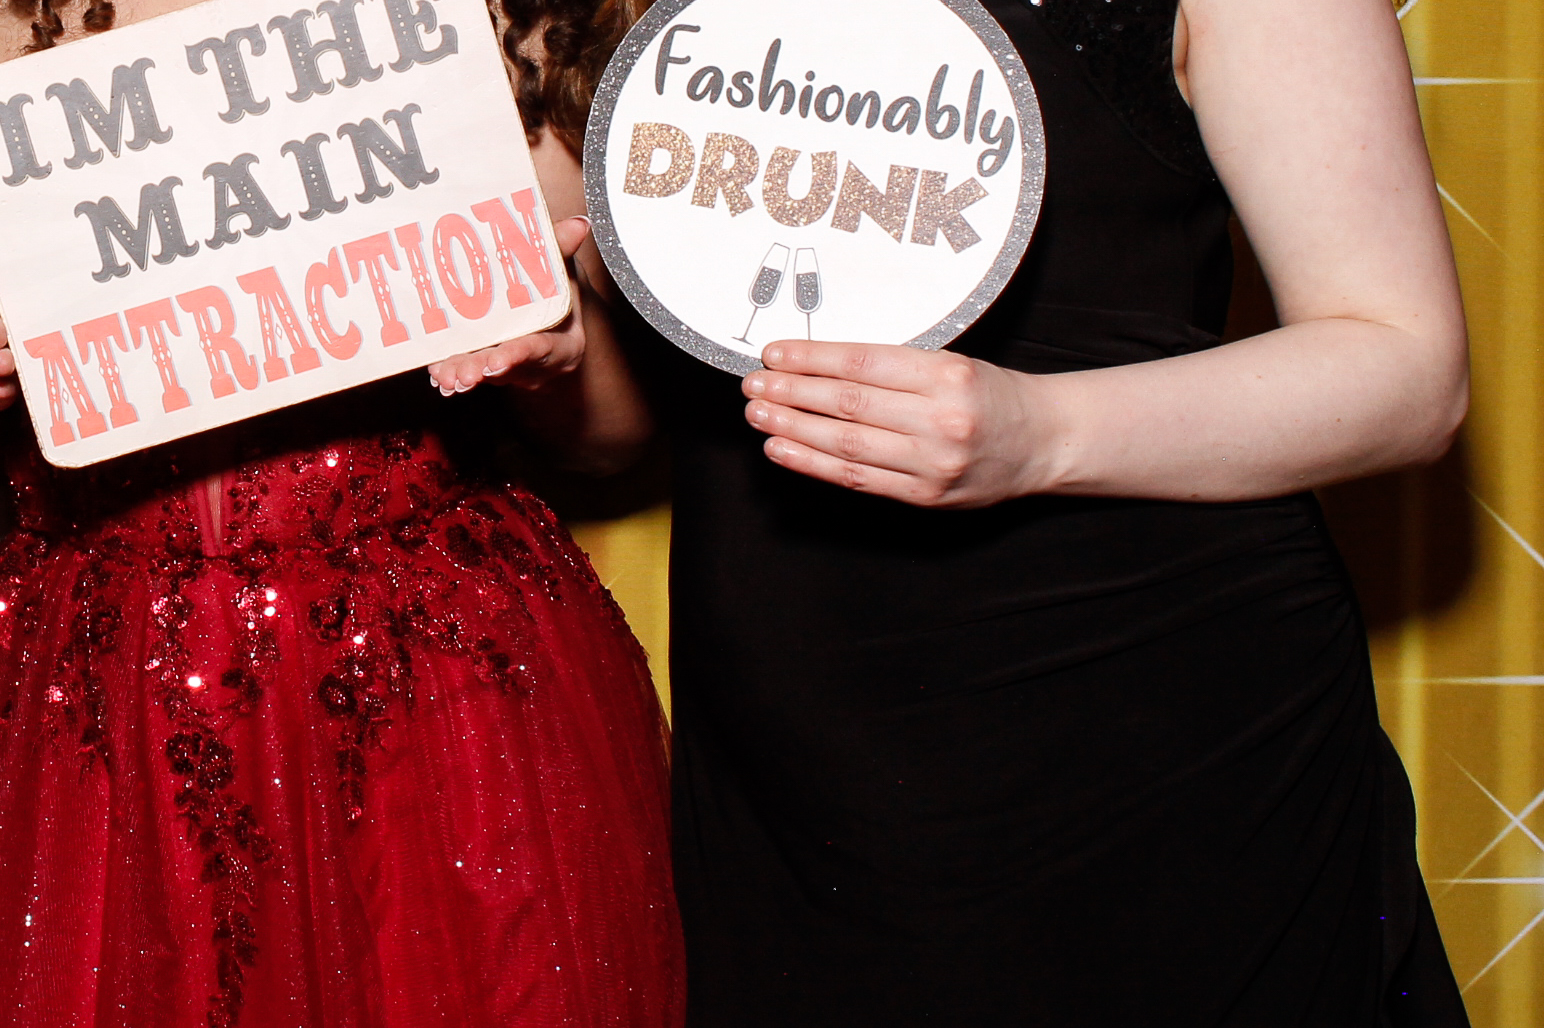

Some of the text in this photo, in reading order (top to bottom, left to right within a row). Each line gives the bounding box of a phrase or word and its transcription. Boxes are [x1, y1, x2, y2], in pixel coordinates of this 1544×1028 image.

[654, 23, 1015, 178] Fashionably
[73, 103, 440, 284] MAIN
[622, 121, 990, 254] DRUNK
[23, 187, 560, 448] ATTRACTION
